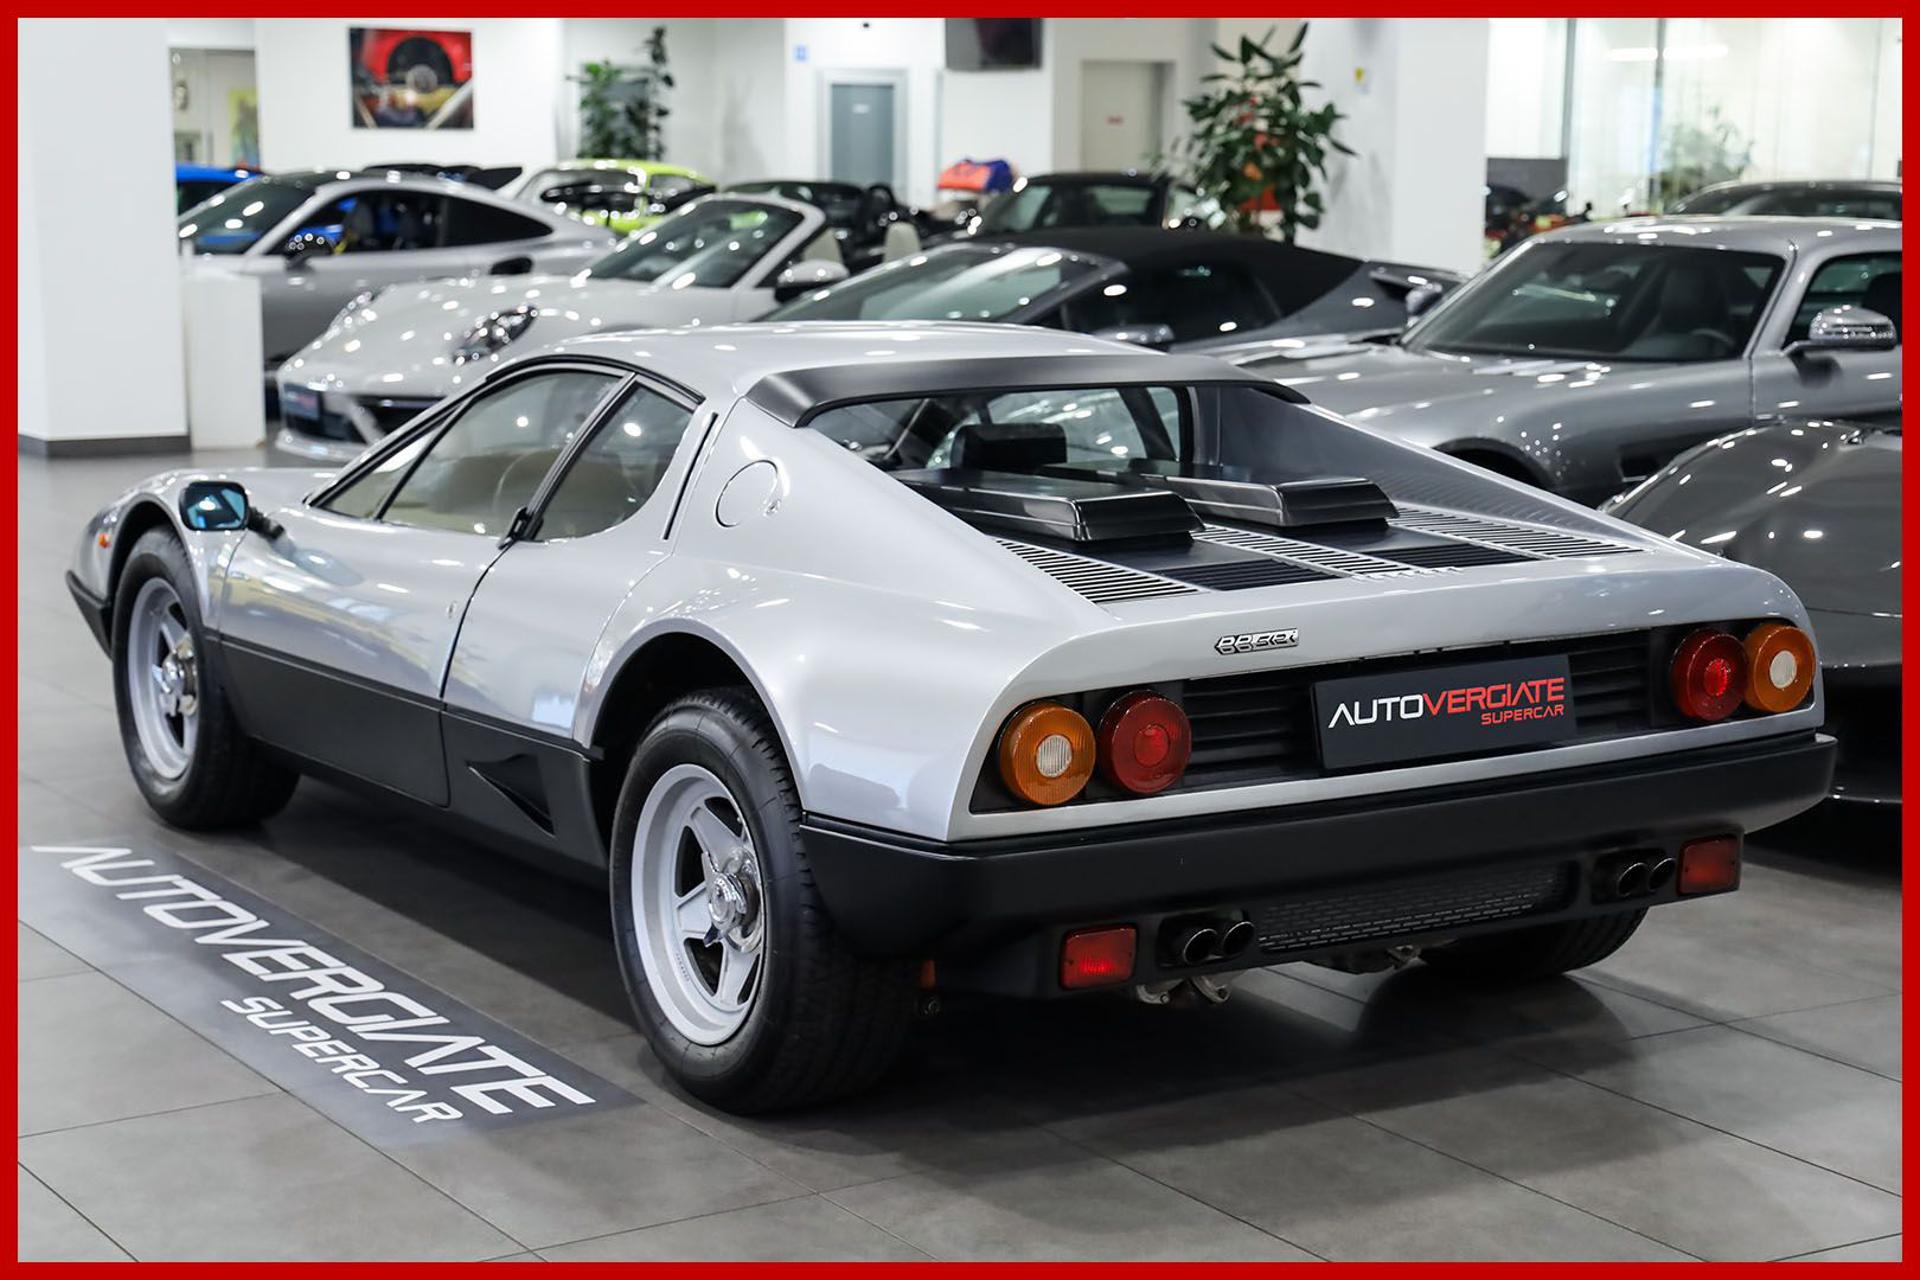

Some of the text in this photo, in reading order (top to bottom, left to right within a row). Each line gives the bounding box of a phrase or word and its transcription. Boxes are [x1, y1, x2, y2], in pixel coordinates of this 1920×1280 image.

[1328, 677, 1565, 729] AUTOVERGIATE
[1480, 703, 1565, 726] SUPERCAR
[31, 845, 597, 1115] AUTOVERGIATE
[221, 996, 463, 1124] SUPERCAR
